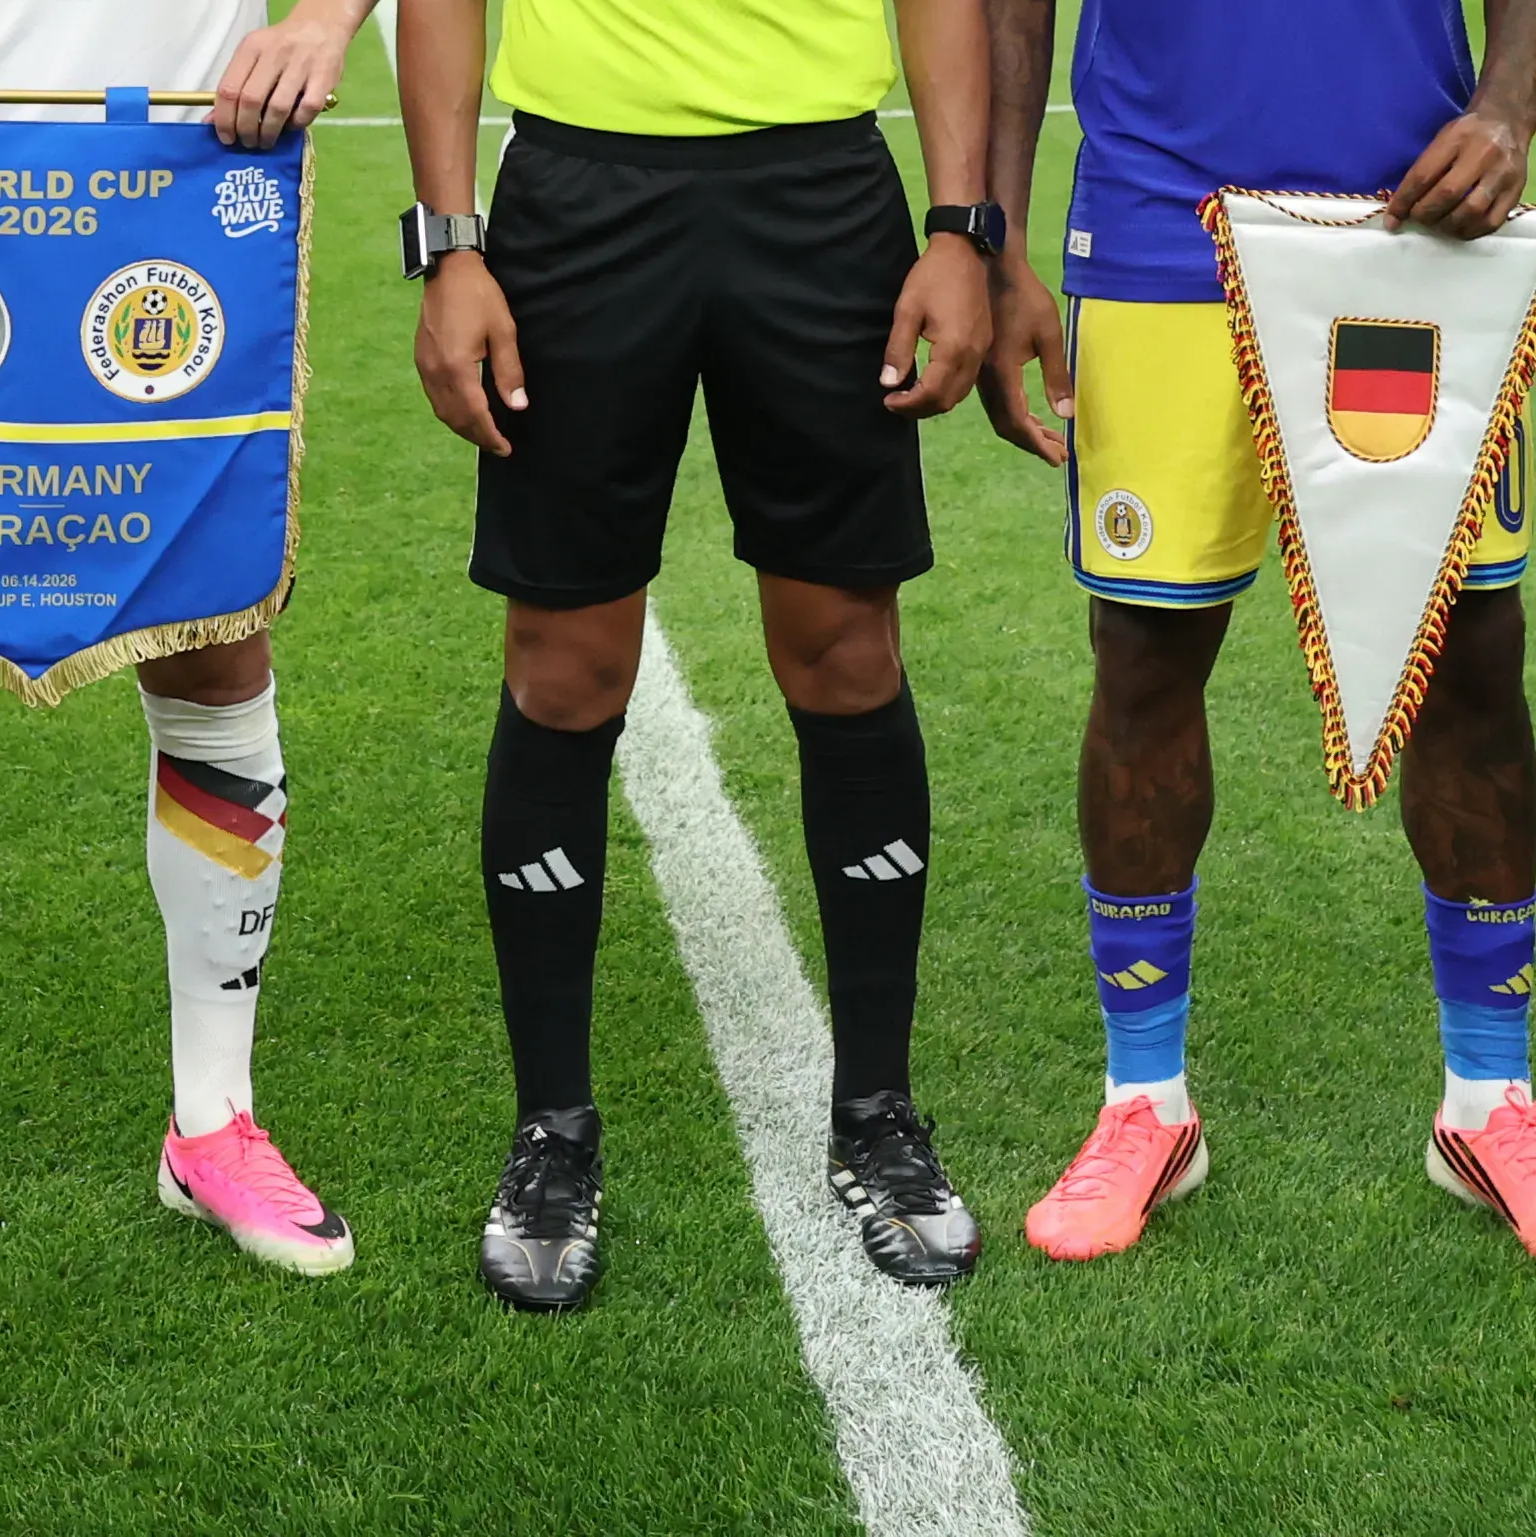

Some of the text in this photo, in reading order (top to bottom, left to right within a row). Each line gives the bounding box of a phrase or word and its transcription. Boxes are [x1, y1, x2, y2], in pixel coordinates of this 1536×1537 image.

[88, 169, 174, 200] CUP
[225, 166, 267, 186] THE
[214, 177, 281, 206] BLUE
[211, 198, 285, 227] WAVE
[91, 275, 138, 381] Federashon
[147, 267, 208, 303] Futbòl
[1494, 416, 1525, 534] 0
[1, 574, 77, 588] 06.14.2026
[21, 594, 36, 608] E,
[40, 593, 117, 607] HOUSTON
[238, 903, 274, 936] DF
[1091, 898, 1171, 921] CURAÇAO
[1466, 904, 1536, 925] CURAÇA
